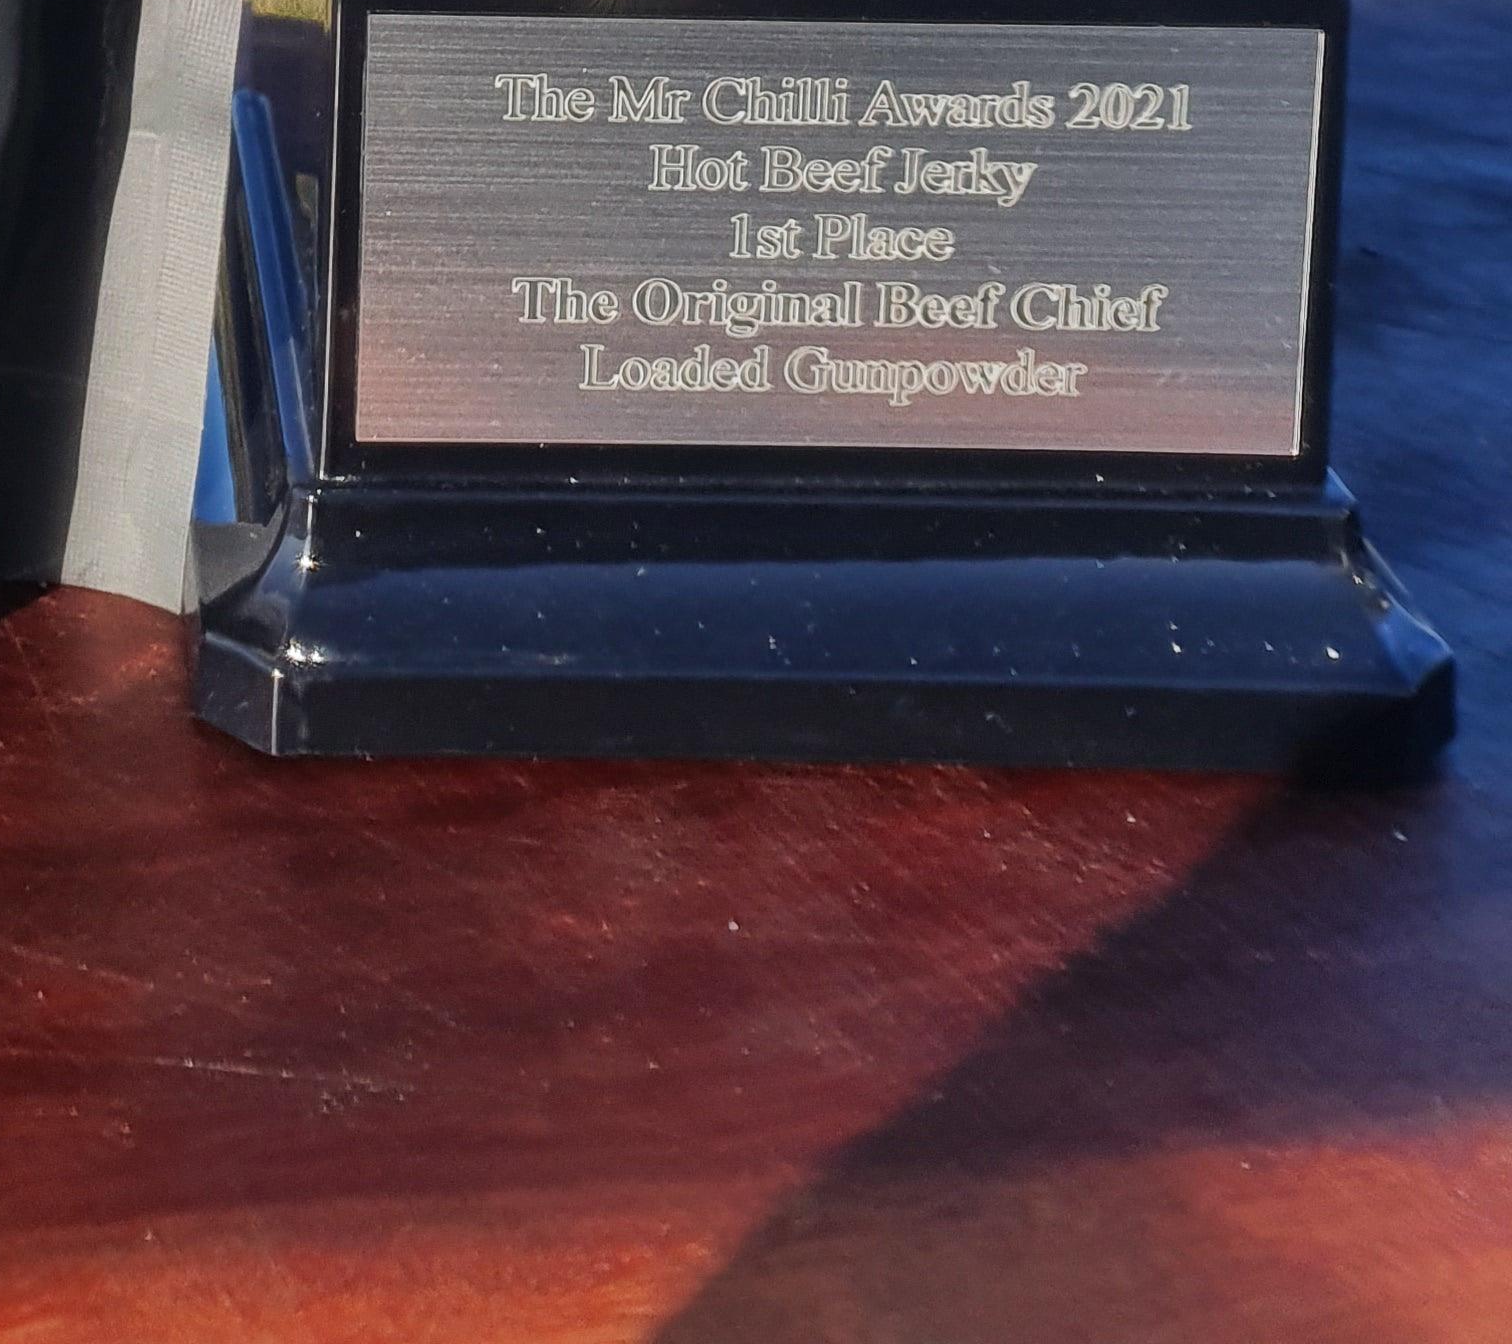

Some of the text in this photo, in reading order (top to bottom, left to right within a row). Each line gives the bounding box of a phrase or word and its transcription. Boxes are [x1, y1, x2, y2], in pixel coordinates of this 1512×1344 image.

[496, 73, 1194, 132] The Mr Chilli Awards 2021
[649, 144, 1038, 206] Hot Beef Jerky
[729, 213, 956, 262] 1st Place
[512, 277, 1169, 337] The Original Beef Chief
[578, 344, 1087, 405] Loaded Gunpowder
